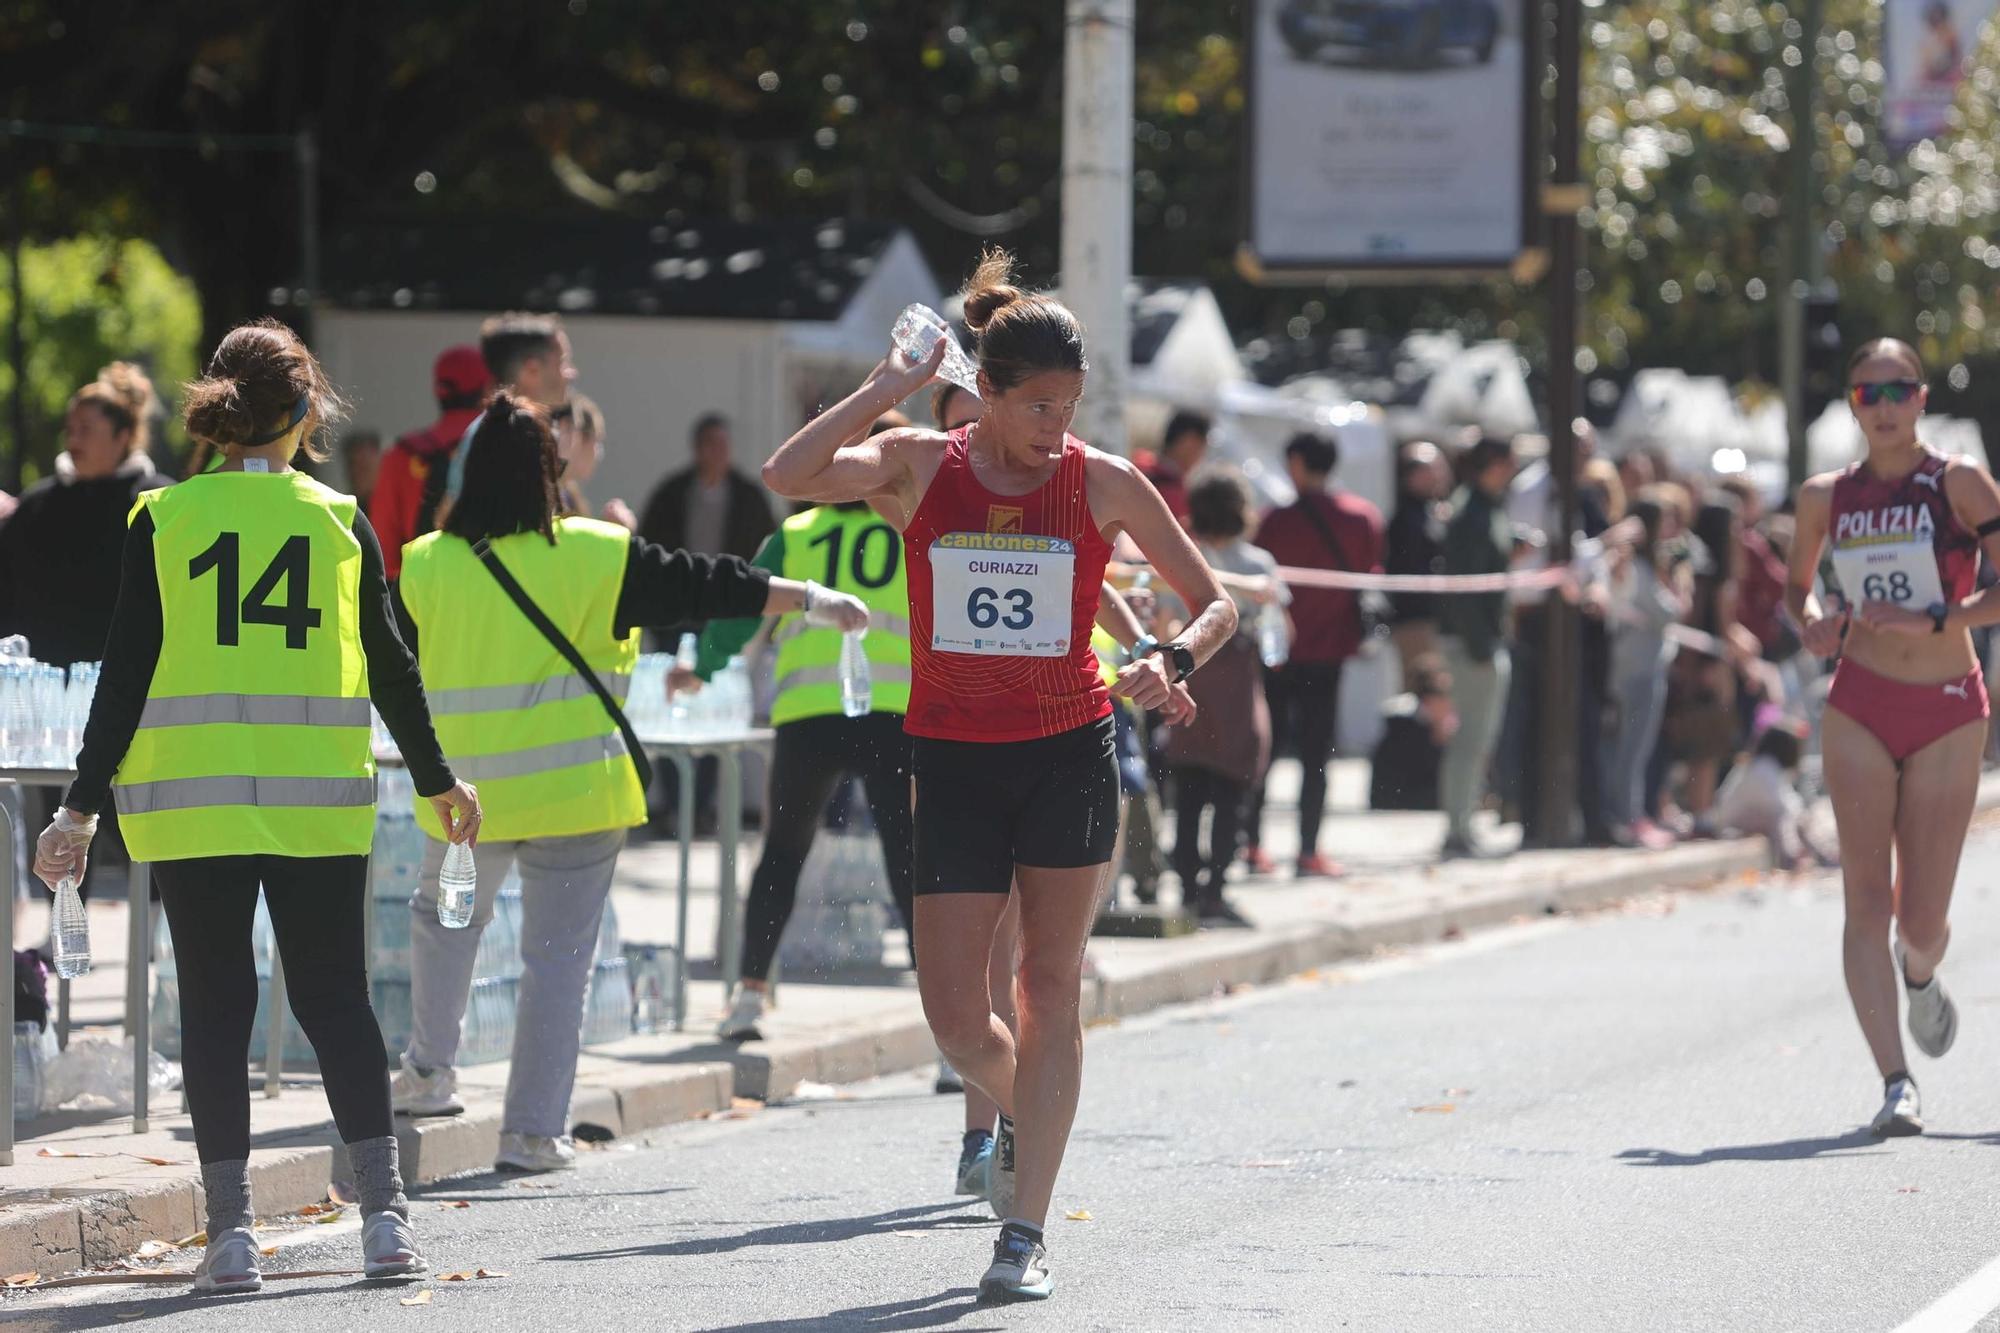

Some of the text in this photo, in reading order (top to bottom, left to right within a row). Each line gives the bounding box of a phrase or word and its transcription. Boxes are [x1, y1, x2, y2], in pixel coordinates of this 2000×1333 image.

[1836, 502, 1935, 541] POLIZIA
[808, 524, 900, 589] 10
[939, 532, 1072, 553] cantones24
[968, 560, 1039, 576] CURIAZZI
[1863, 570, 1913, 601] 68
[188, 531, 322, 650] 14
[967, 586, 1035, 631] 63
